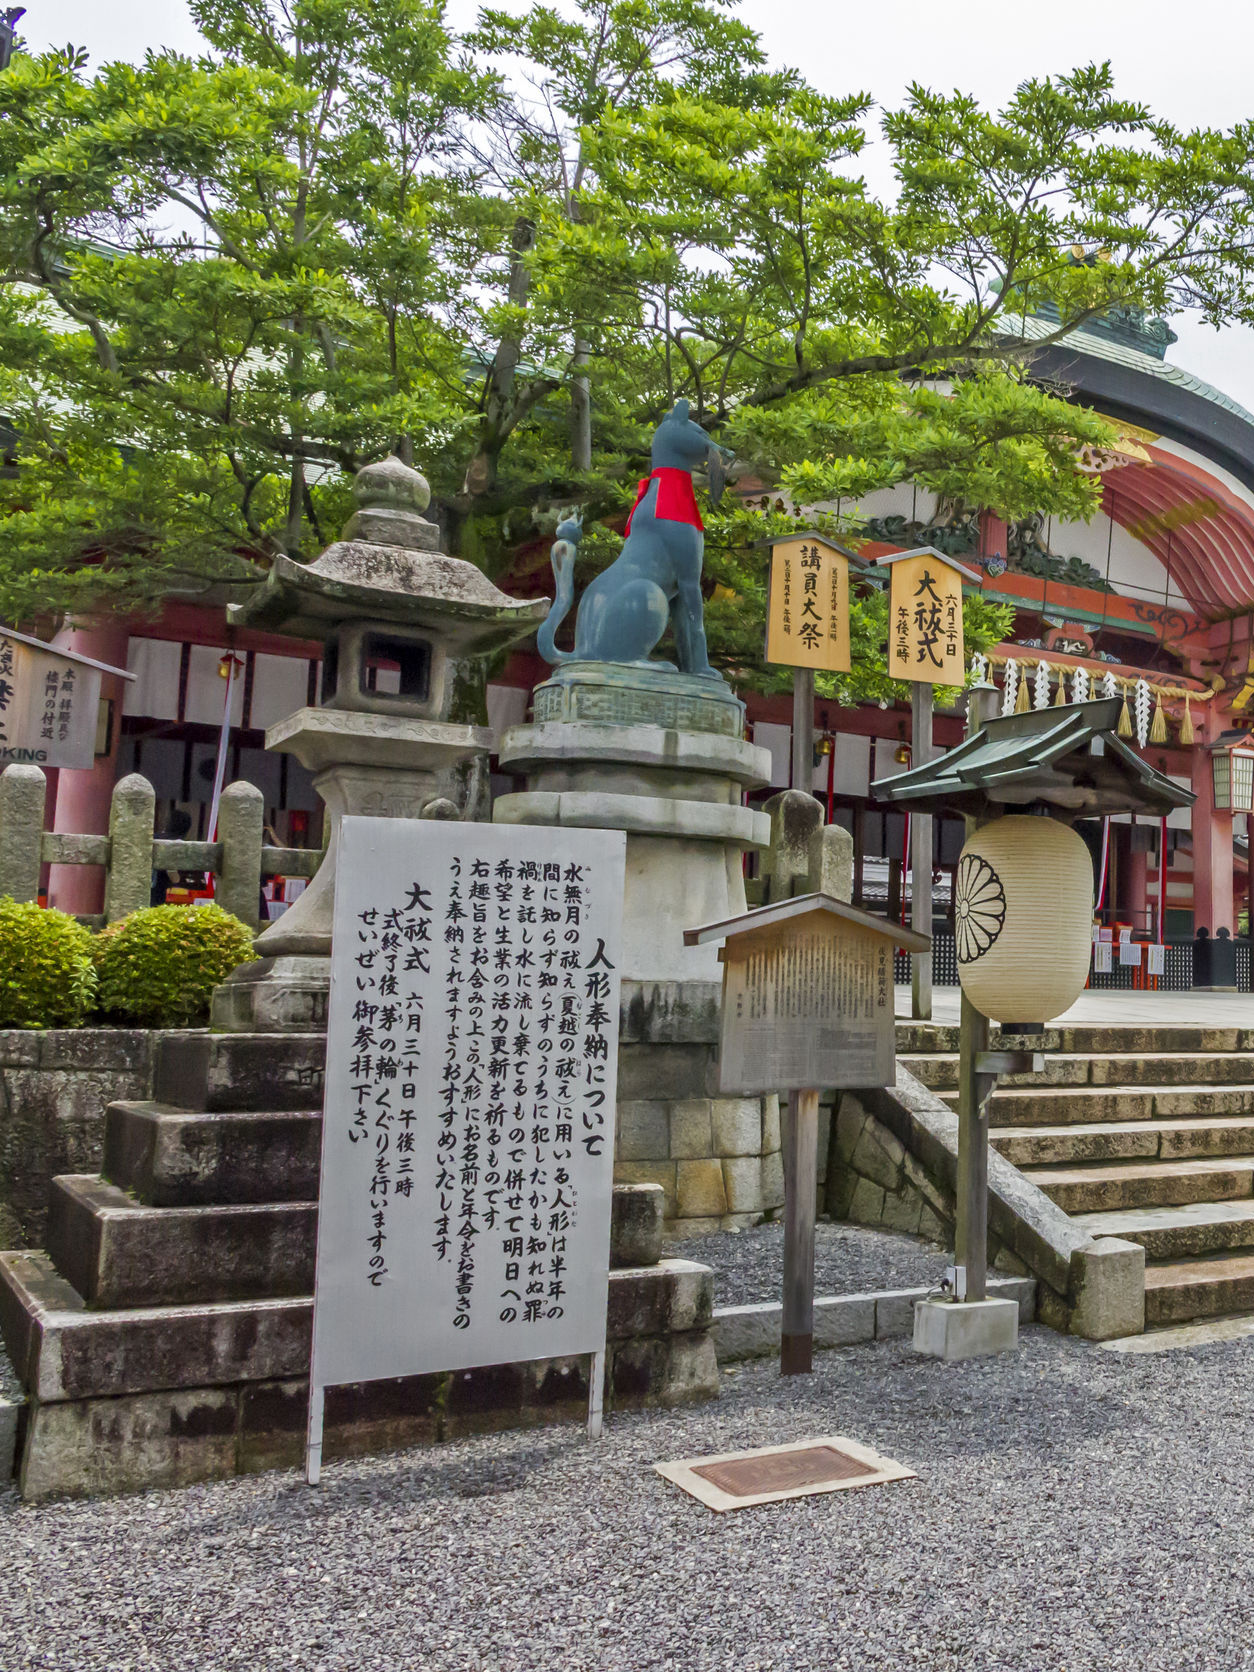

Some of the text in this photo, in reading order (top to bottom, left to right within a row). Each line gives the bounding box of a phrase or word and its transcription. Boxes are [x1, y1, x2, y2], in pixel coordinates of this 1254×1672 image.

[797, 544, 825, 650] 講員大祭
[896, 606, 910, 664] 午後三時
[913, 570, 946, 668] 大祓式
[945, 594, 959, 657] 六月三十日
[0, 747, 48, 762] KING
[402, 882, 434, 974] 大祓式
[582, 938, 616, 1156] 人形奉納について
